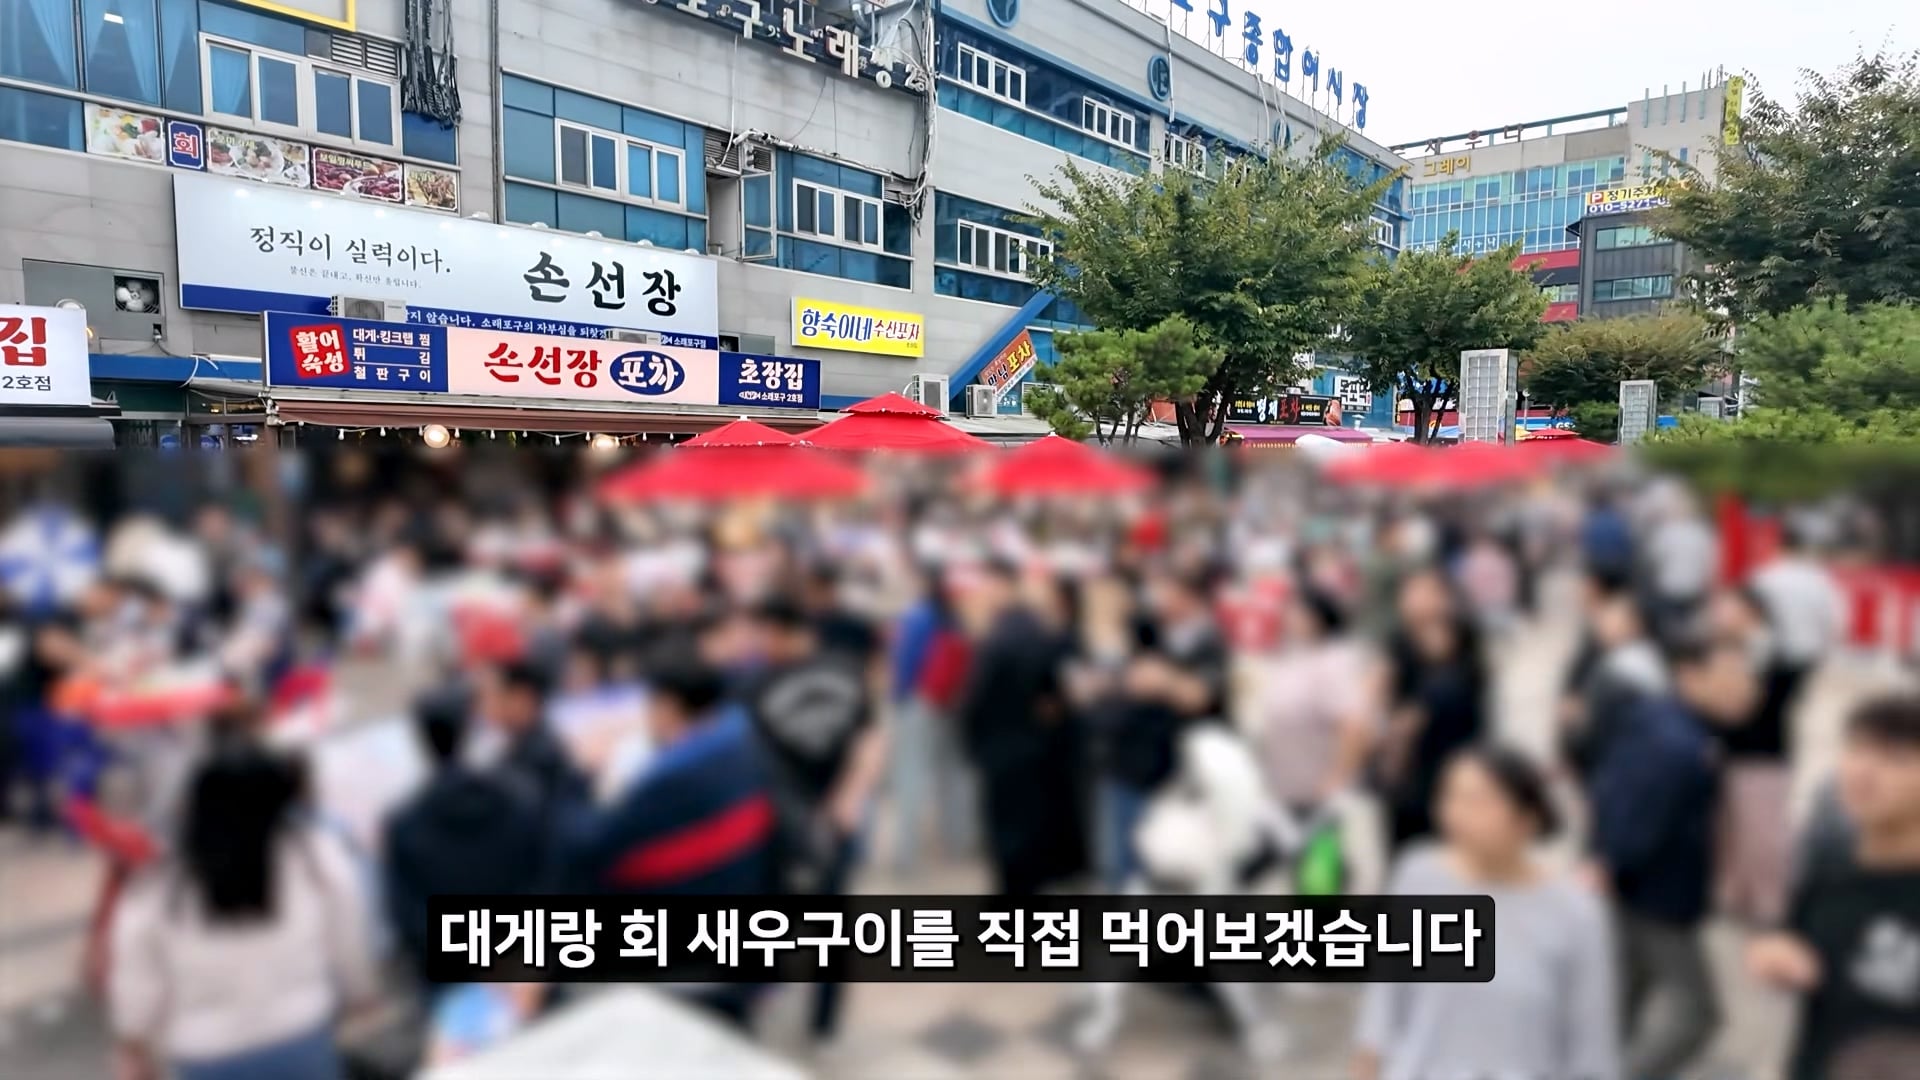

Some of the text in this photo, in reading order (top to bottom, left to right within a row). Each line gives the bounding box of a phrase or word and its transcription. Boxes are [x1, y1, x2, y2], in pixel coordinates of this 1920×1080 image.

[1171, 0, 1369, 129] 구종합어시장
[173, 132, 199, 159] 회
[1424, 155, 1471, 177] 그레이
[1591, 192, 1603, 204] P
[250, 226, 450, 274] 정직이 실력이다.
[523, 251, 682, 316] 손선장
[426, 311, 476, 327] 않습니다.
[481, 317, 533, 332] 소래포구의
[537, 322, 577, 337] 자부심을
[802, 309, 920, 341] 향숙이네 수산포차
[0, 317, 46, 366] 집
[295, 329, 341, 354] 활어
[418, 333, 431, 346] 찜
[673, 336, 707, 349] 소래포구점
[301, 351, 344, 374] 숙성
[484, 343, 679, 391] 손선장 포차
[1007, 340, 1032, 373] 포차
[2, 374, 51, 391] 2호점
[353, 366, 431, 383] 철판구이
[738, 358, 804, 391] 초장집
[762, 391, 786, 402] 소래포구
